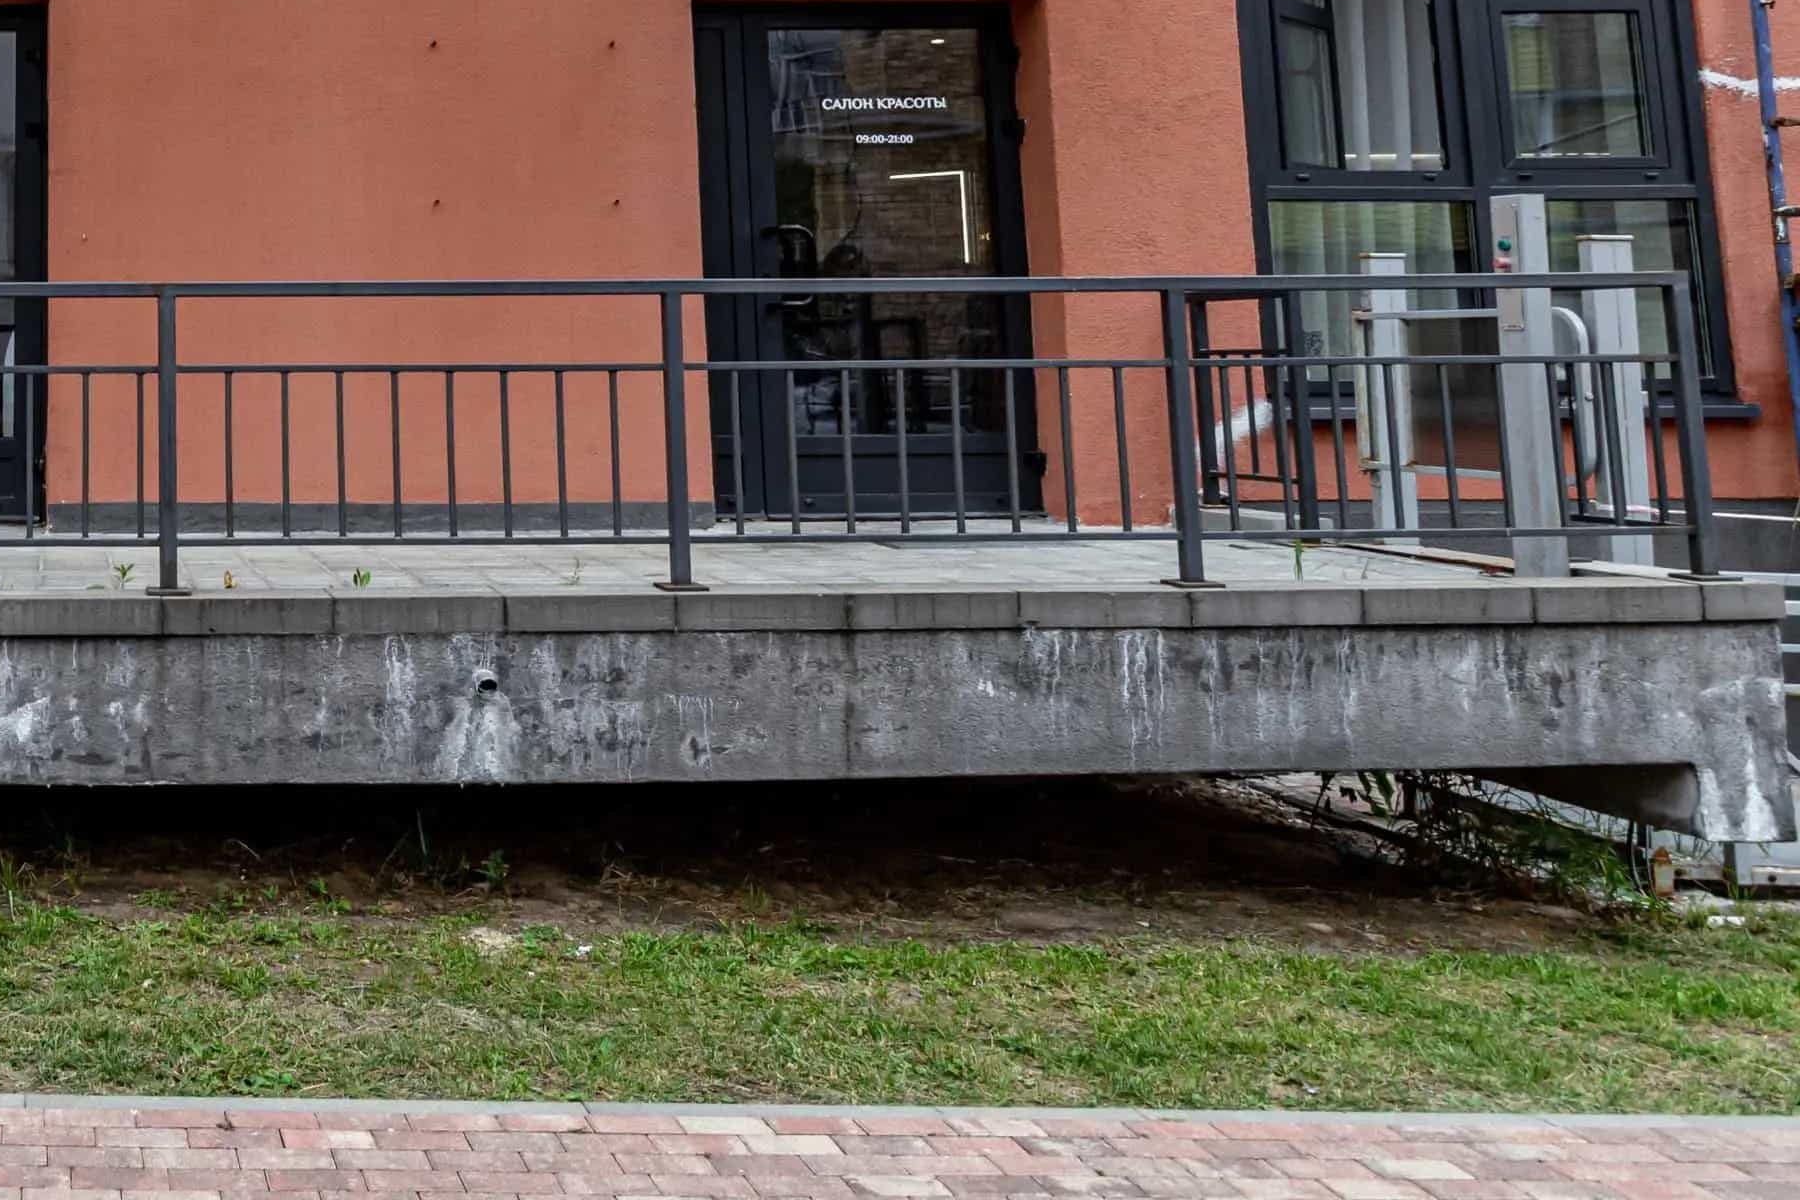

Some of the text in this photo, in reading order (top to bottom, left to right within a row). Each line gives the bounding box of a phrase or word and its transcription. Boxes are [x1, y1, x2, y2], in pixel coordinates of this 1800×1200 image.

[822, 97, 947, 110] САЛОН КРАСОТЫ
[855, 134, 914, 144] 09:00-21:00
